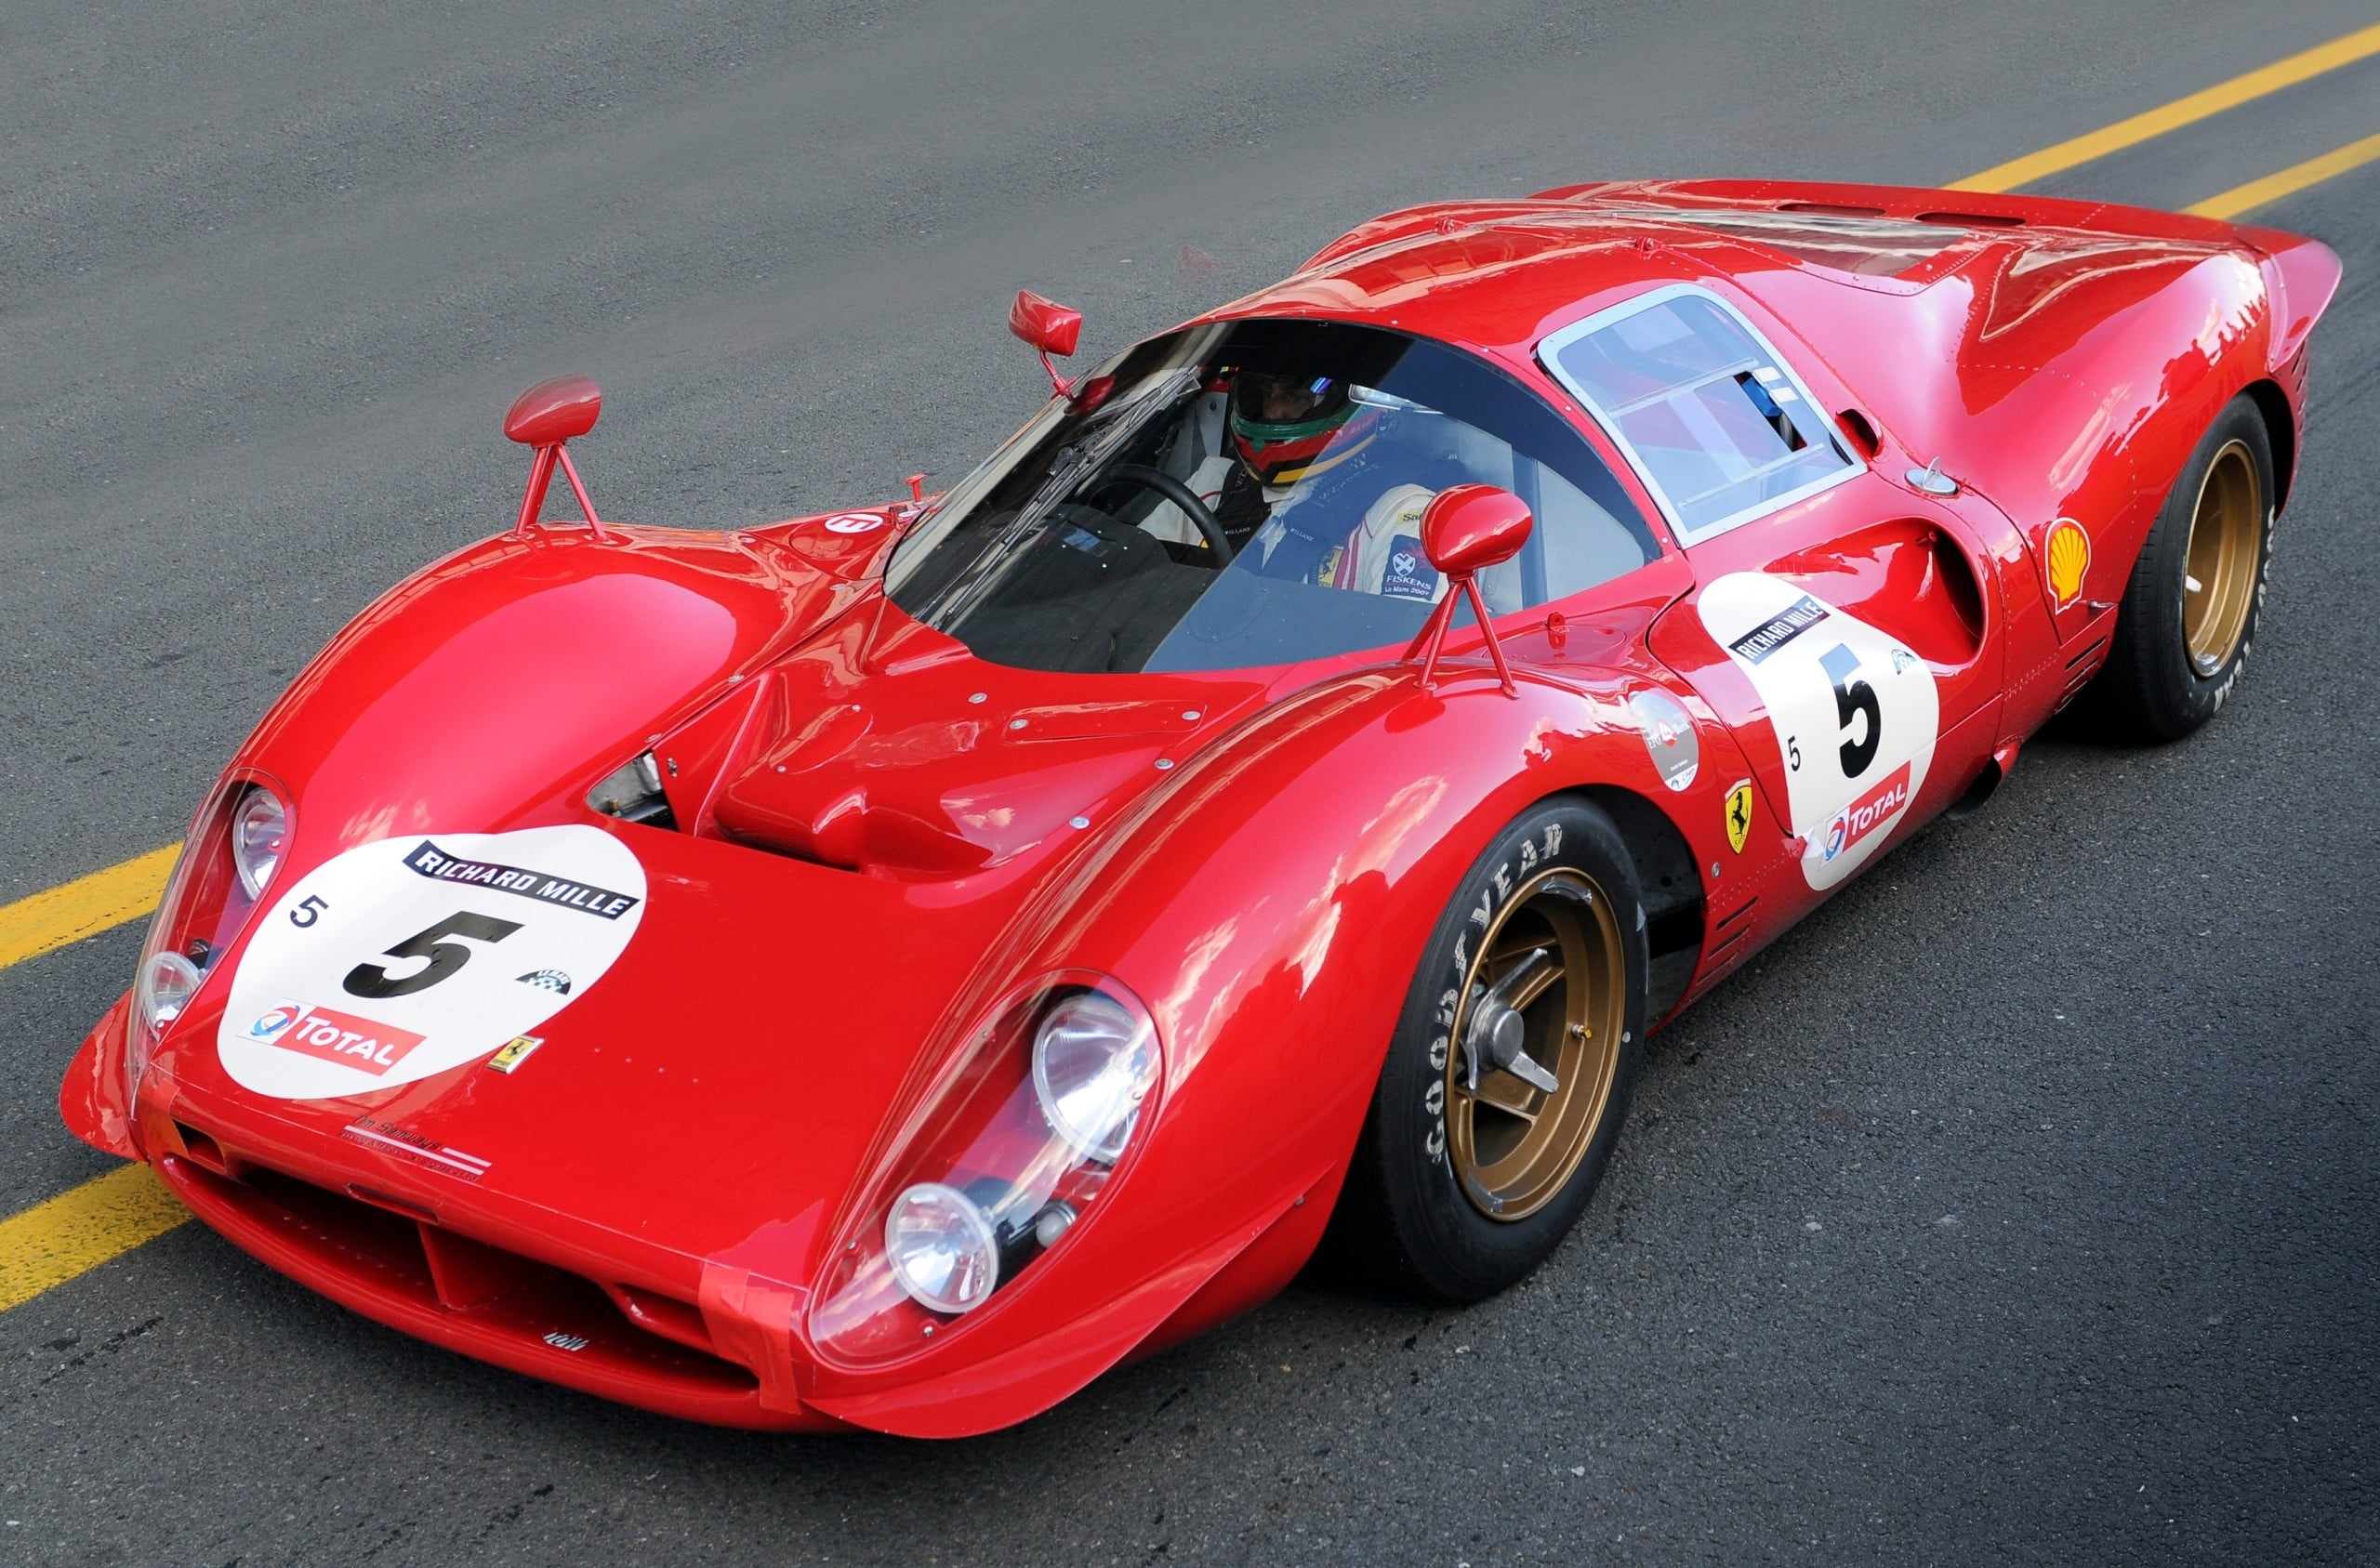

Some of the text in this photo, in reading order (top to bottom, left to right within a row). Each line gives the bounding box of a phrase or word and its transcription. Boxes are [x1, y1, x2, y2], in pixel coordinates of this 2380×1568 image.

[1386, 575, 1432, 590] FISKENS
[1736, 601, 1824, 660] RICHARD MILLE
[1818, 642, 1882, 779] 5
[1787, 735, 1801, 771] 5
[1850, 783, 1906, 837] TOTAL
[415, 850, 630, 916] RICHARD MILLE
[290, 894, 329, 928] 5
[342, 911, 525, 998] 5
[296, 1016, 395, 1066] TOTAL
